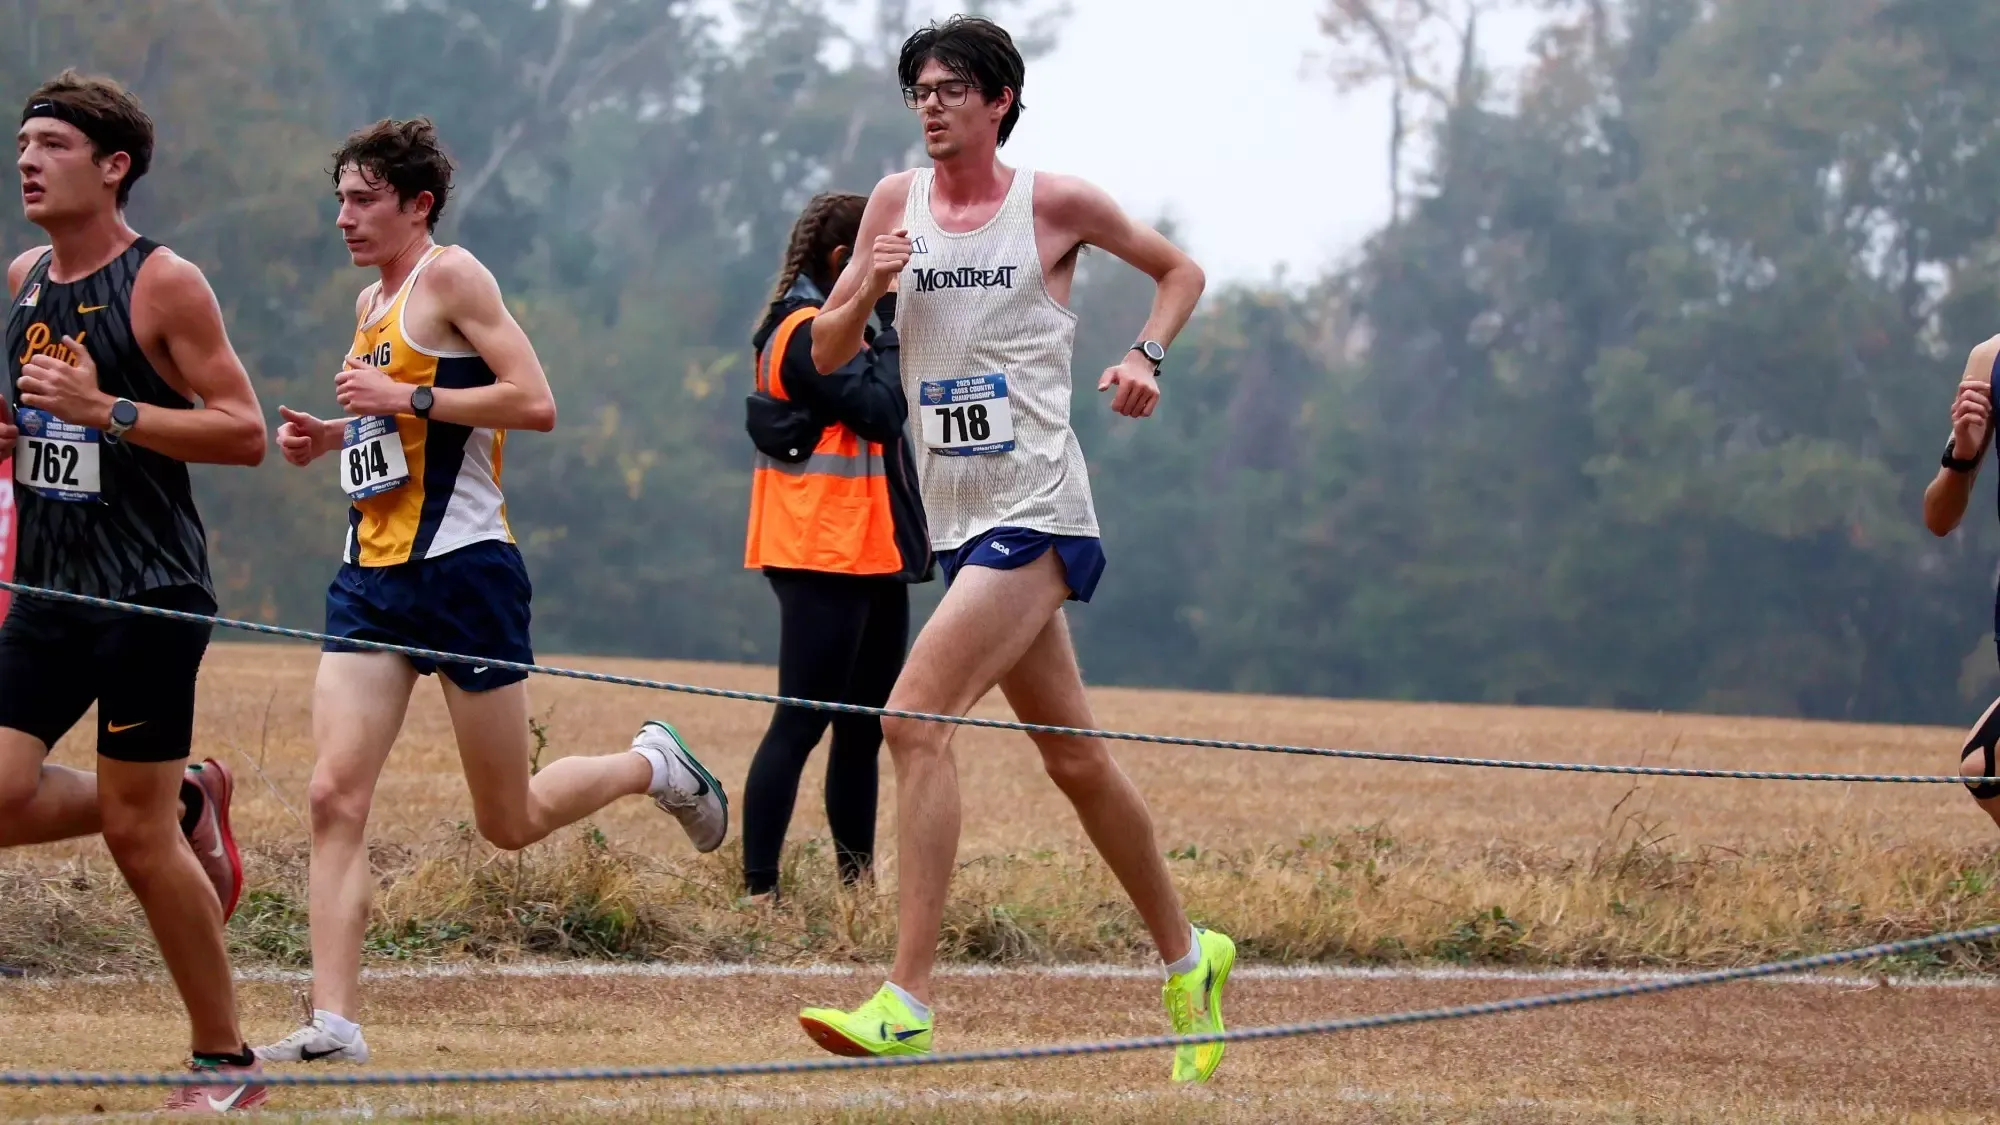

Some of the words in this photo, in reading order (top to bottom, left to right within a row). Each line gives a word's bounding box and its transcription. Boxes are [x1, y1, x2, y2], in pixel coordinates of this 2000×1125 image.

[912, 265, 1018, 294] MONTREAT
[951, 386, 969, 395] CROSS
[969, 383, 995, 393] COUNTRY
[951, 390, 996, 402] CHAMPIONSHIPS
[955, 379, 971, 387] 2025
[935, 404, 991, 443] 718
[29, 440, 79, 486] 762
[349, 440, 389, 486] 814
